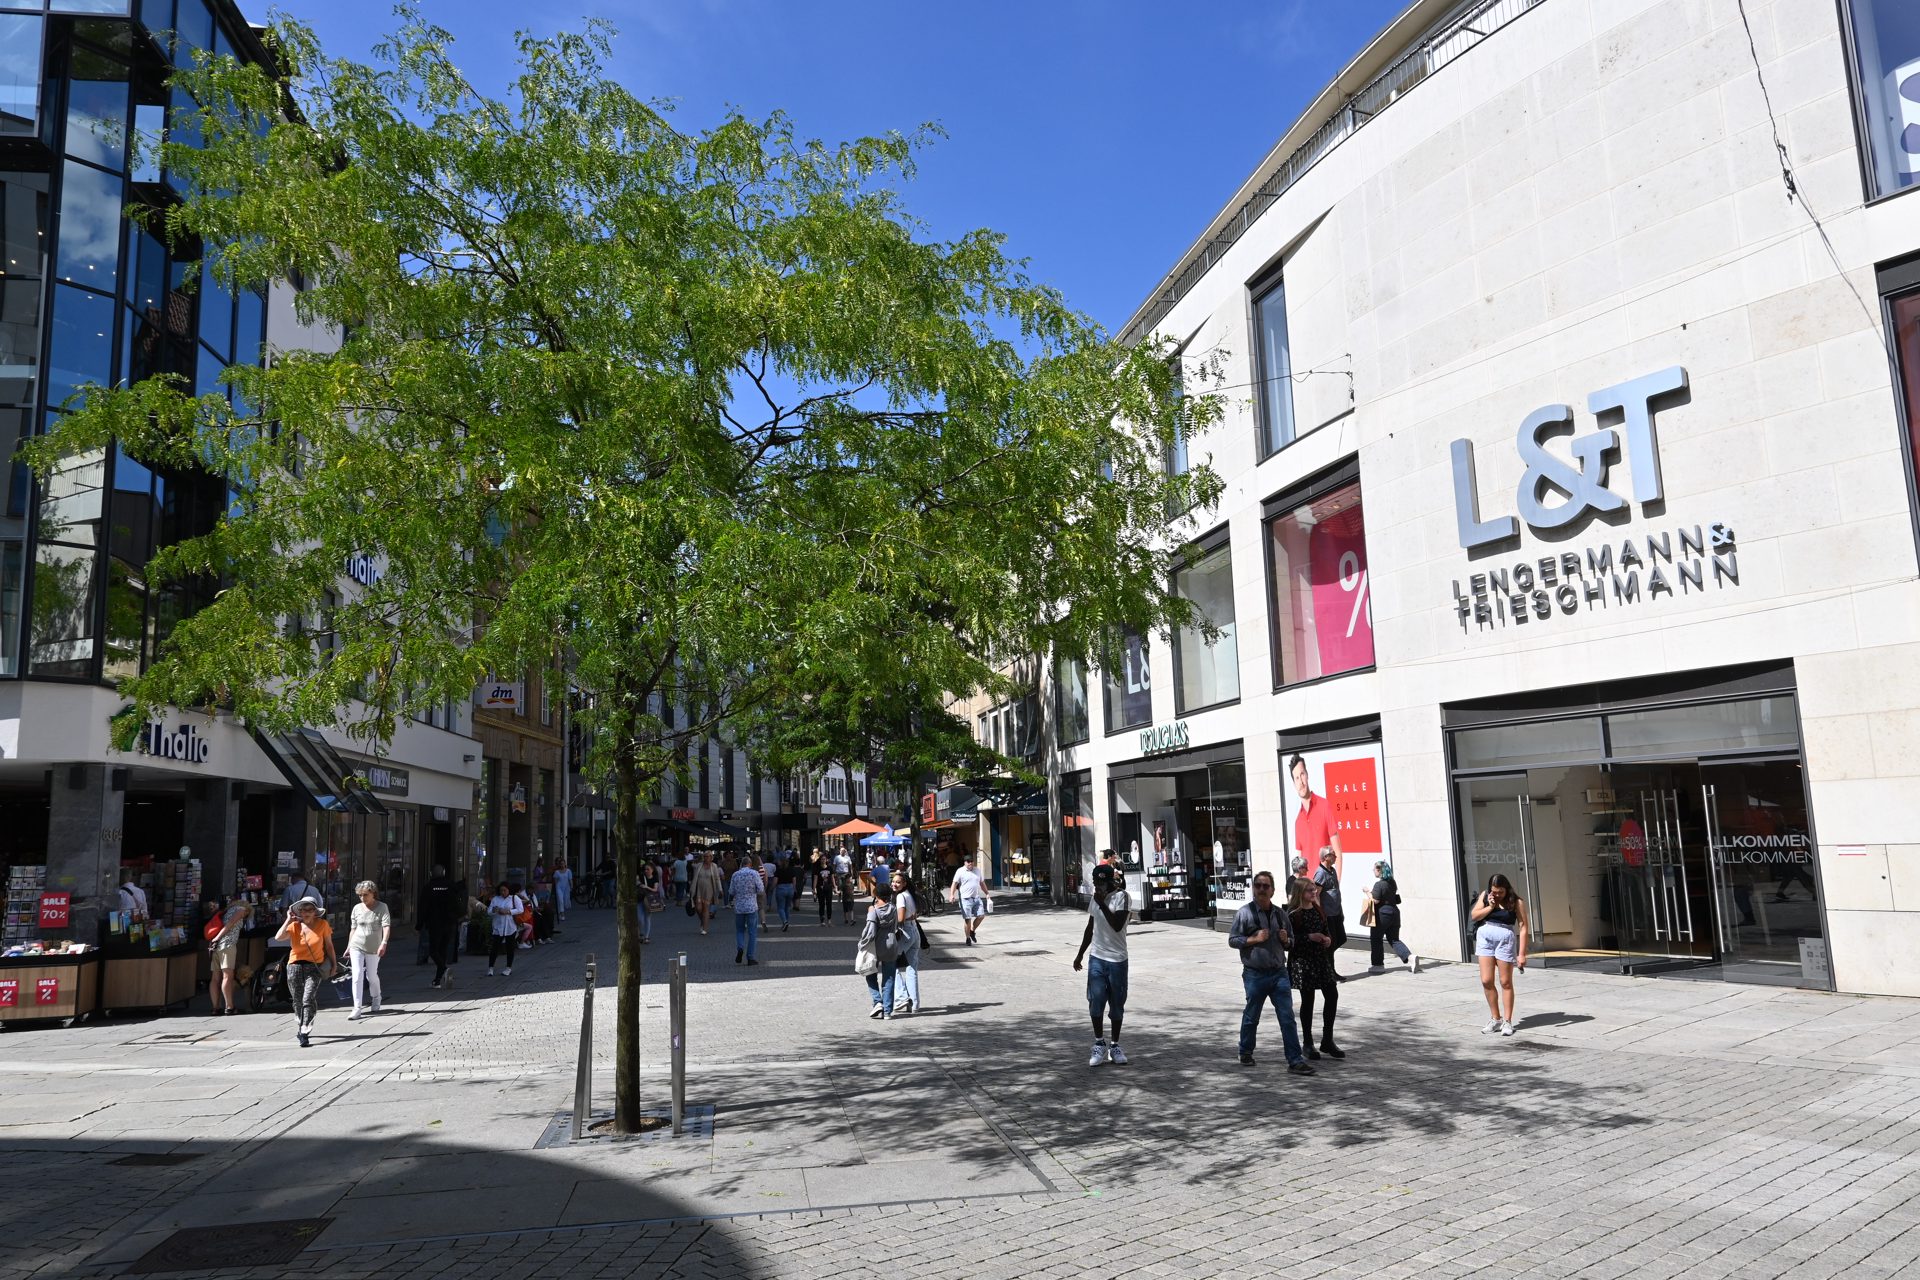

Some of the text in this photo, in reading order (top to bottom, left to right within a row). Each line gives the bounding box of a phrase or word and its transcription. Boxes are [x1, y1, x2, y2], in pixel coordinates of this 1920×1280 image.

[1450, 365, 1688, 549] L&T
[492, 686, 512, 698] dm
[147, 718, 208, 763] Thalia
[1140, 721, 1189, 753] DOUGLAS
[1335, 782, 1367, 793] SALE
[1336, 801, 1368, 812] SALE
[1338, 820, 1370, 831] SALE
[43, 897, 66, 906] SALE
